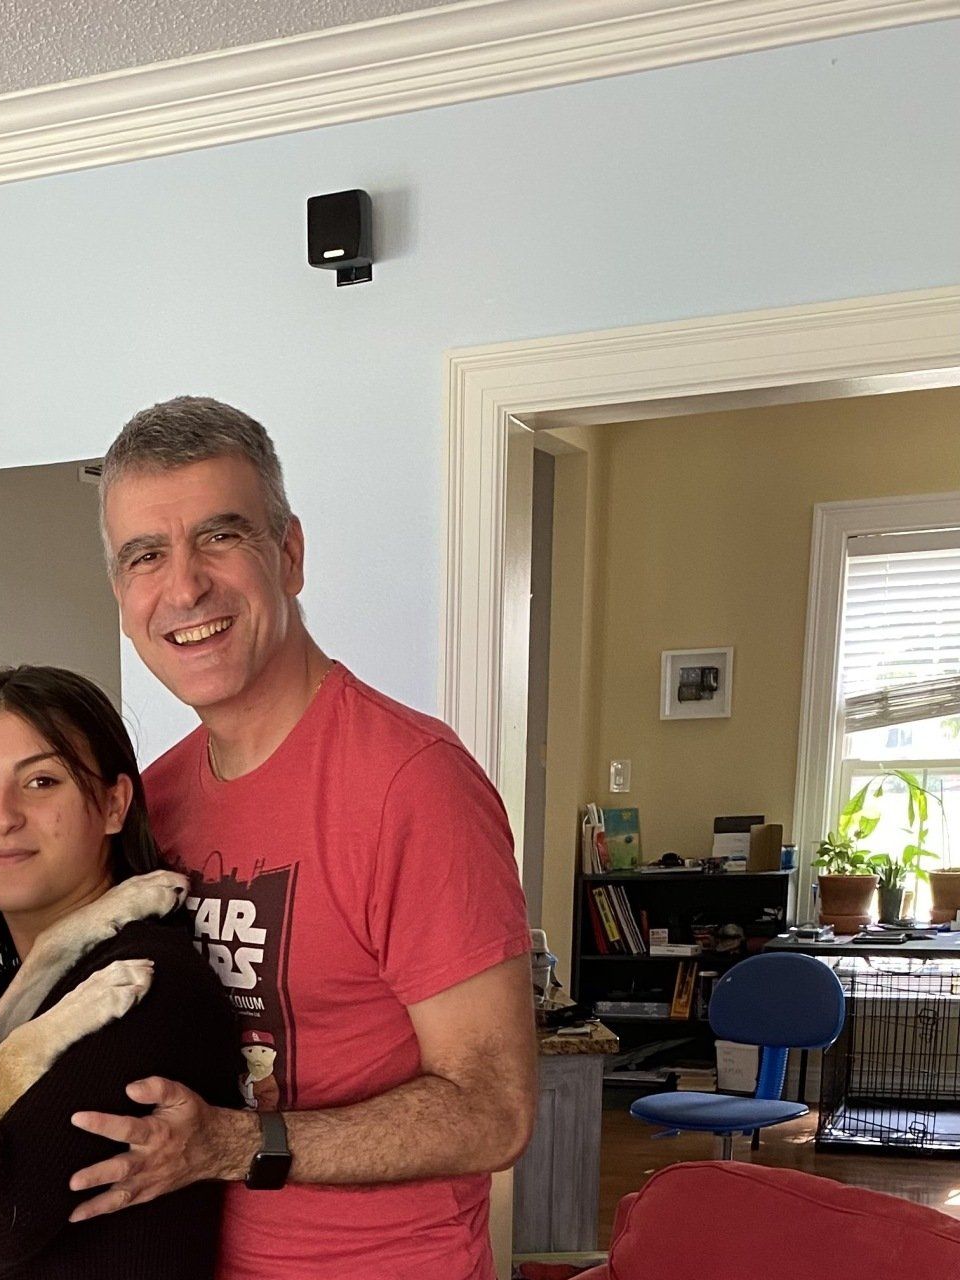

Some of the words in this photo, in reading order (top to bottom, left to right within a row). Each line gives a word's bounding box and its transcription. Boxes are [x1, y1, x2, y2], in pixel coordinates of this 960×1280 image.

[186, 896, 267, 945] AR
[192, 940, 265, 990] RS
[229, 994, 265, 1011] DIUM
